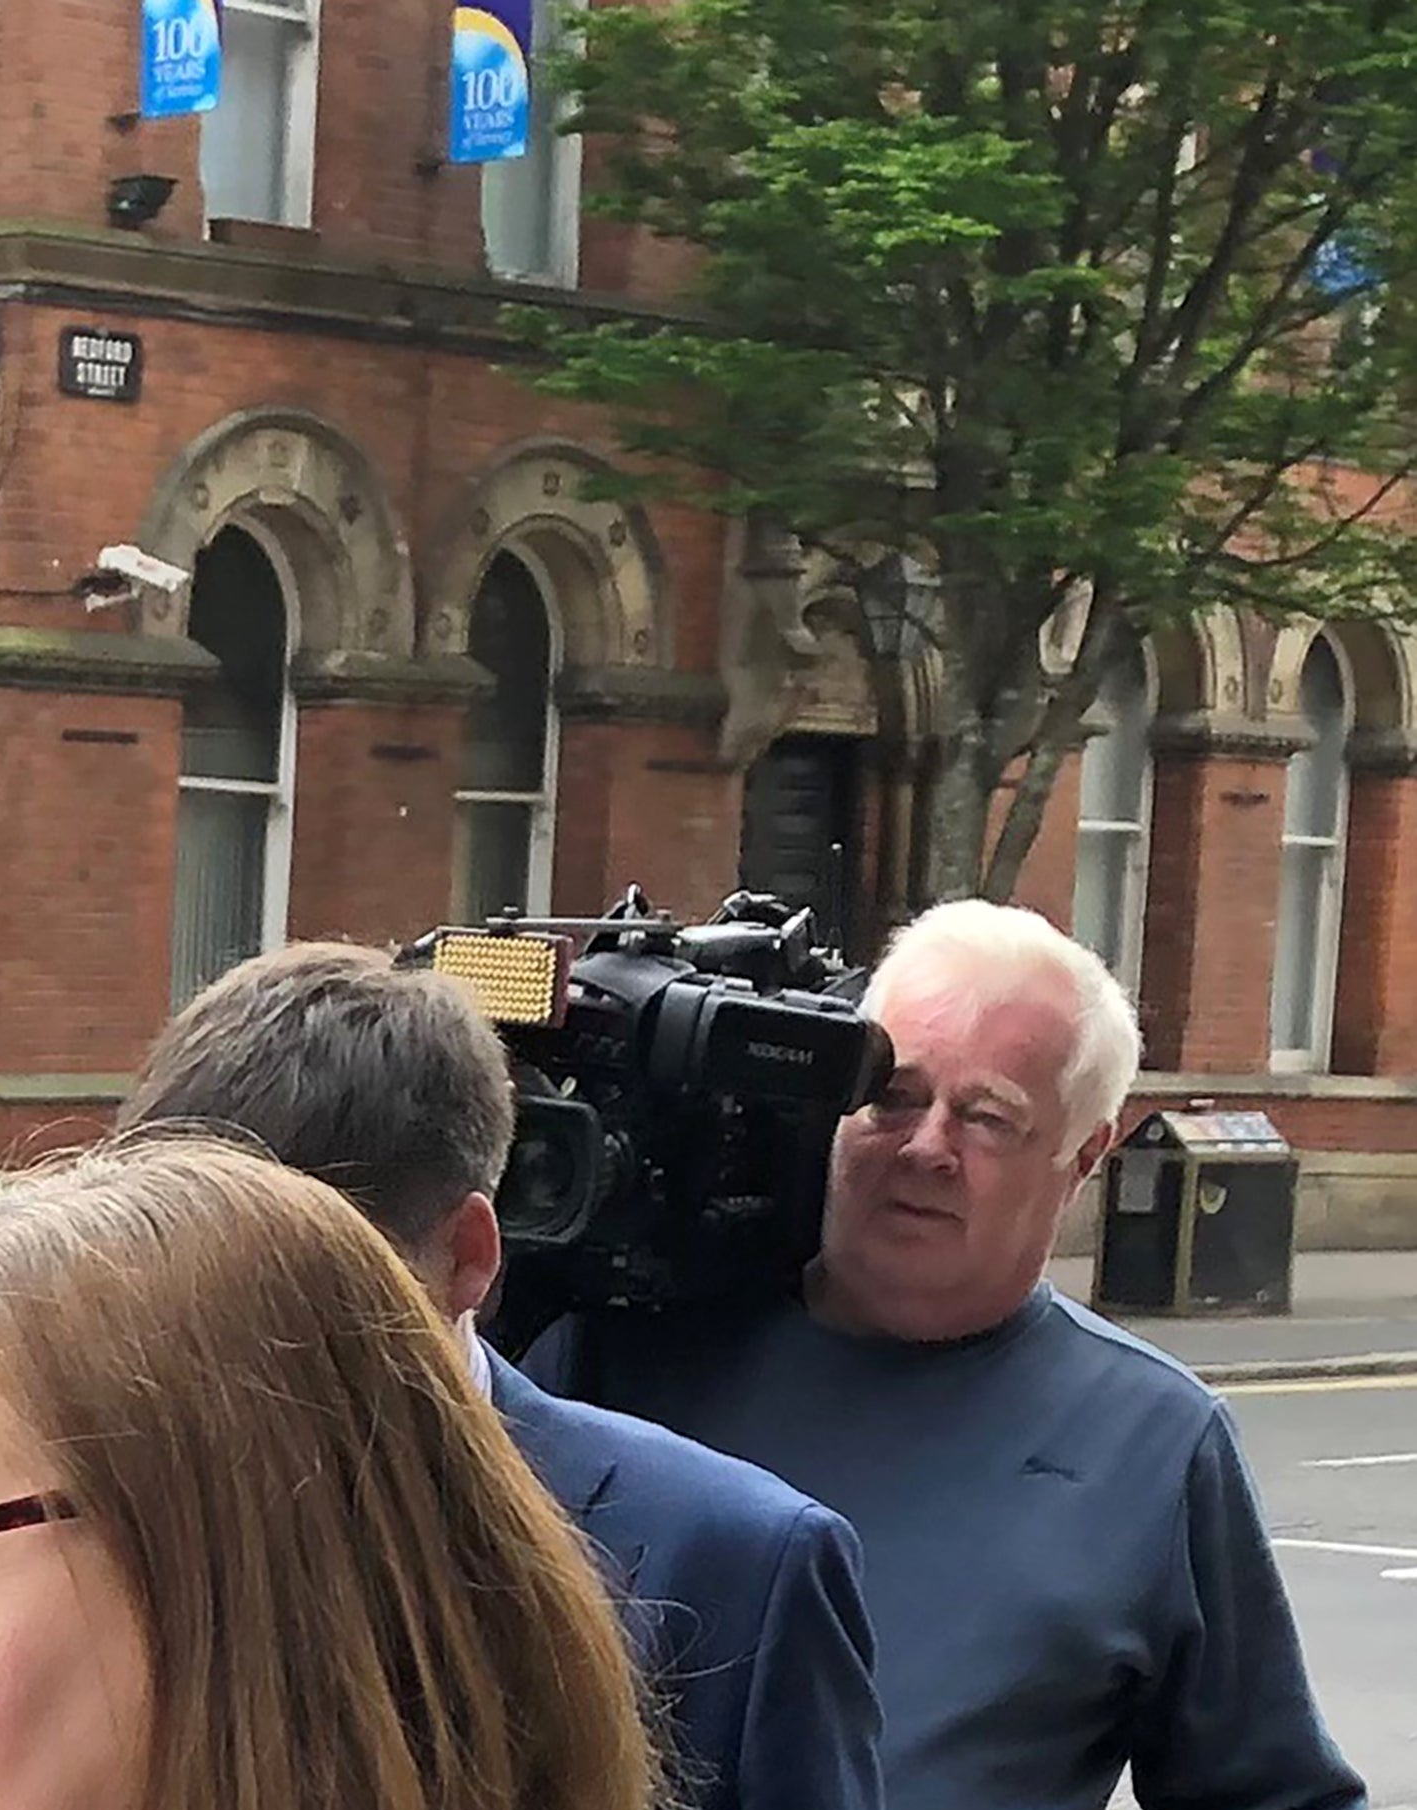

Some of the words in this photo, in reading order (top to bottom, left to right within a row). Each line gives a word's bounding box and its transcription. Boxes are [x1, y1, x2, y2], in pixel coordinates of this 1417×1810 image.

[153, 17, 208, 61] 100
[153, 60, 206, 82] YEARS
[462, 68, 518, 110] 100
[464, 109, 514, 129] YEARS
[72, 336, 132, 363] BEDFORD
[76, 362, 126, 386] STREET
